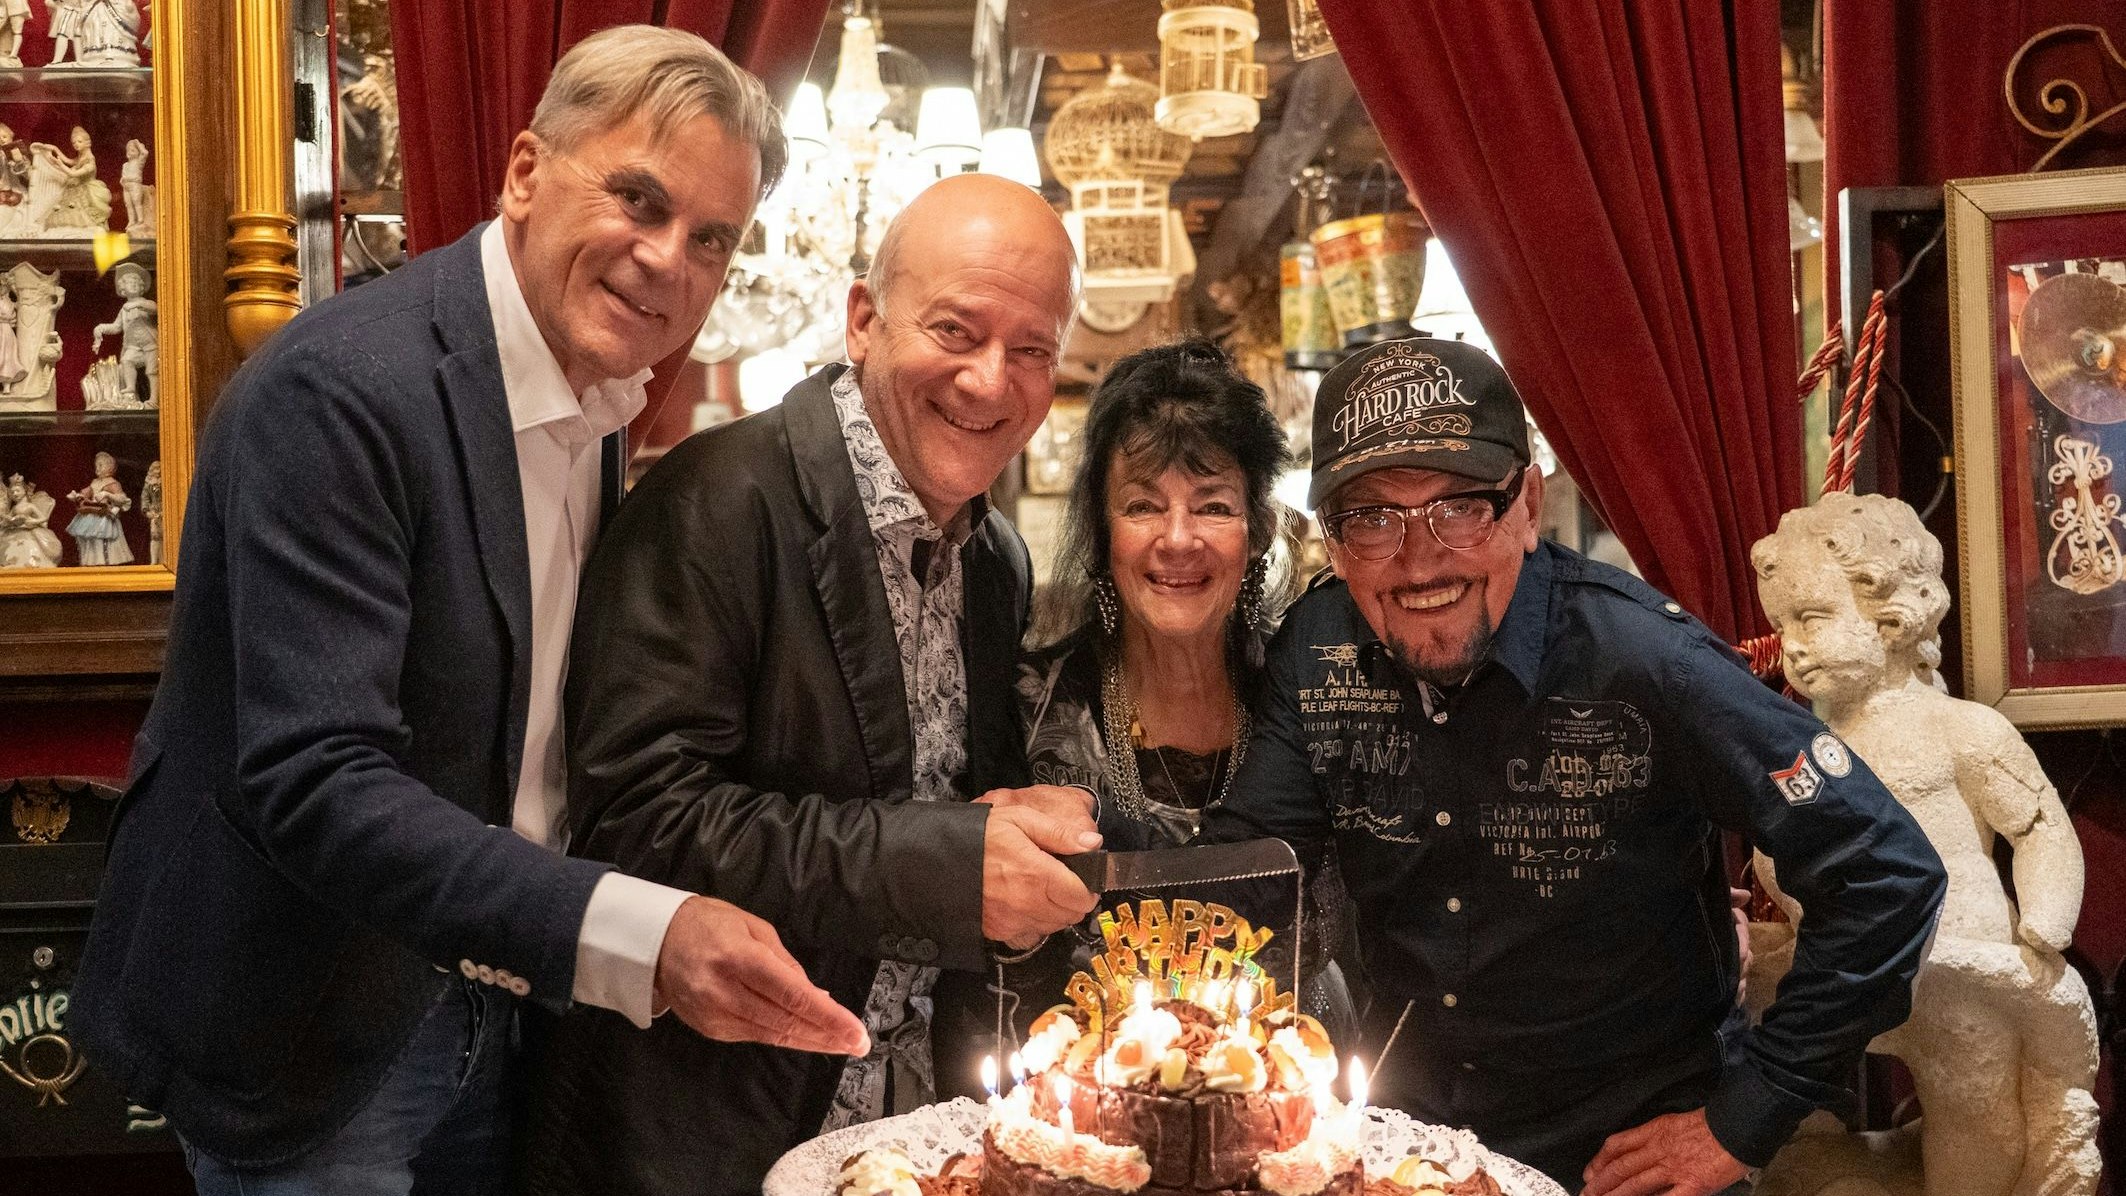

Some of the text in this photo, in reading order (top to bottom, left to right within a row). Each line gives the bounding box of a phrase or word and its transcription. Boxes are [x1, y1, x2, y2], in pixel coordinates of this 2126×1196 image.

[1373, 358, 1426, 374] NEW YORK
[1371, 370, 1416, 389] AUTHENTIC
[1332, 365, 1477, 452] HARD ROCK
[1382, 408, 1422, 428] CAFE
[1327, 686, 1349, 699] JOHN
[1349, 687, 1389, 701] SEAPLANE
[1318, 701, 1339, 713] LEAF
[1786, 767, 1816, 797] 63
[1493, 842, 1513, 857] REF
[1097, 898, 1275, 956] HAPPY
